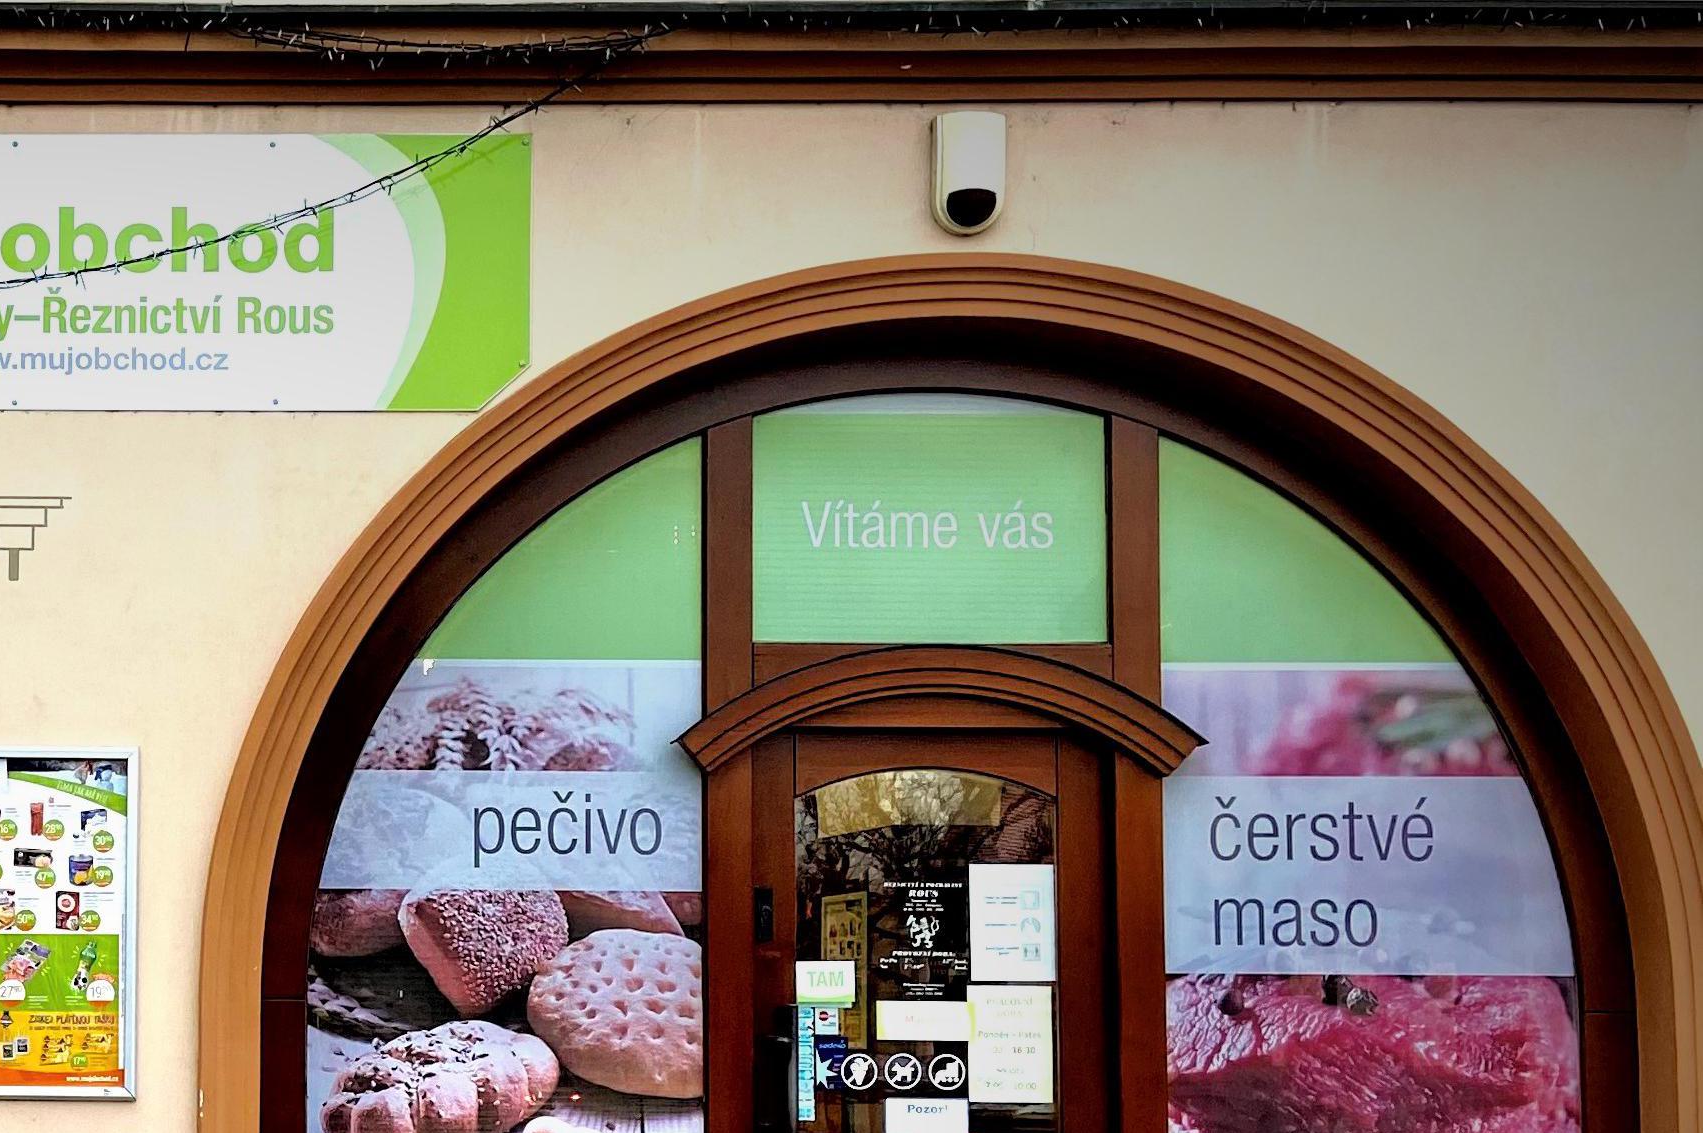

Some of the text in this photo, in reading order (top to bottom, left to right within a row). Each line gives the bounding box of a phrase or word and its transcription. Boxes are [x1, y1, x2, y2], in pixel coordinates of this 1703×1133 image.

[238, 297, 335, 335] Rous
[801, 500, 1054, 550] Vítáme vás
[473, 790, 662, 868] pečivo
[1209, 796, 1434, 862] čerstvé
[1213, 898, 1378, 948] maso
[807, 971, 844, 987] TAM
